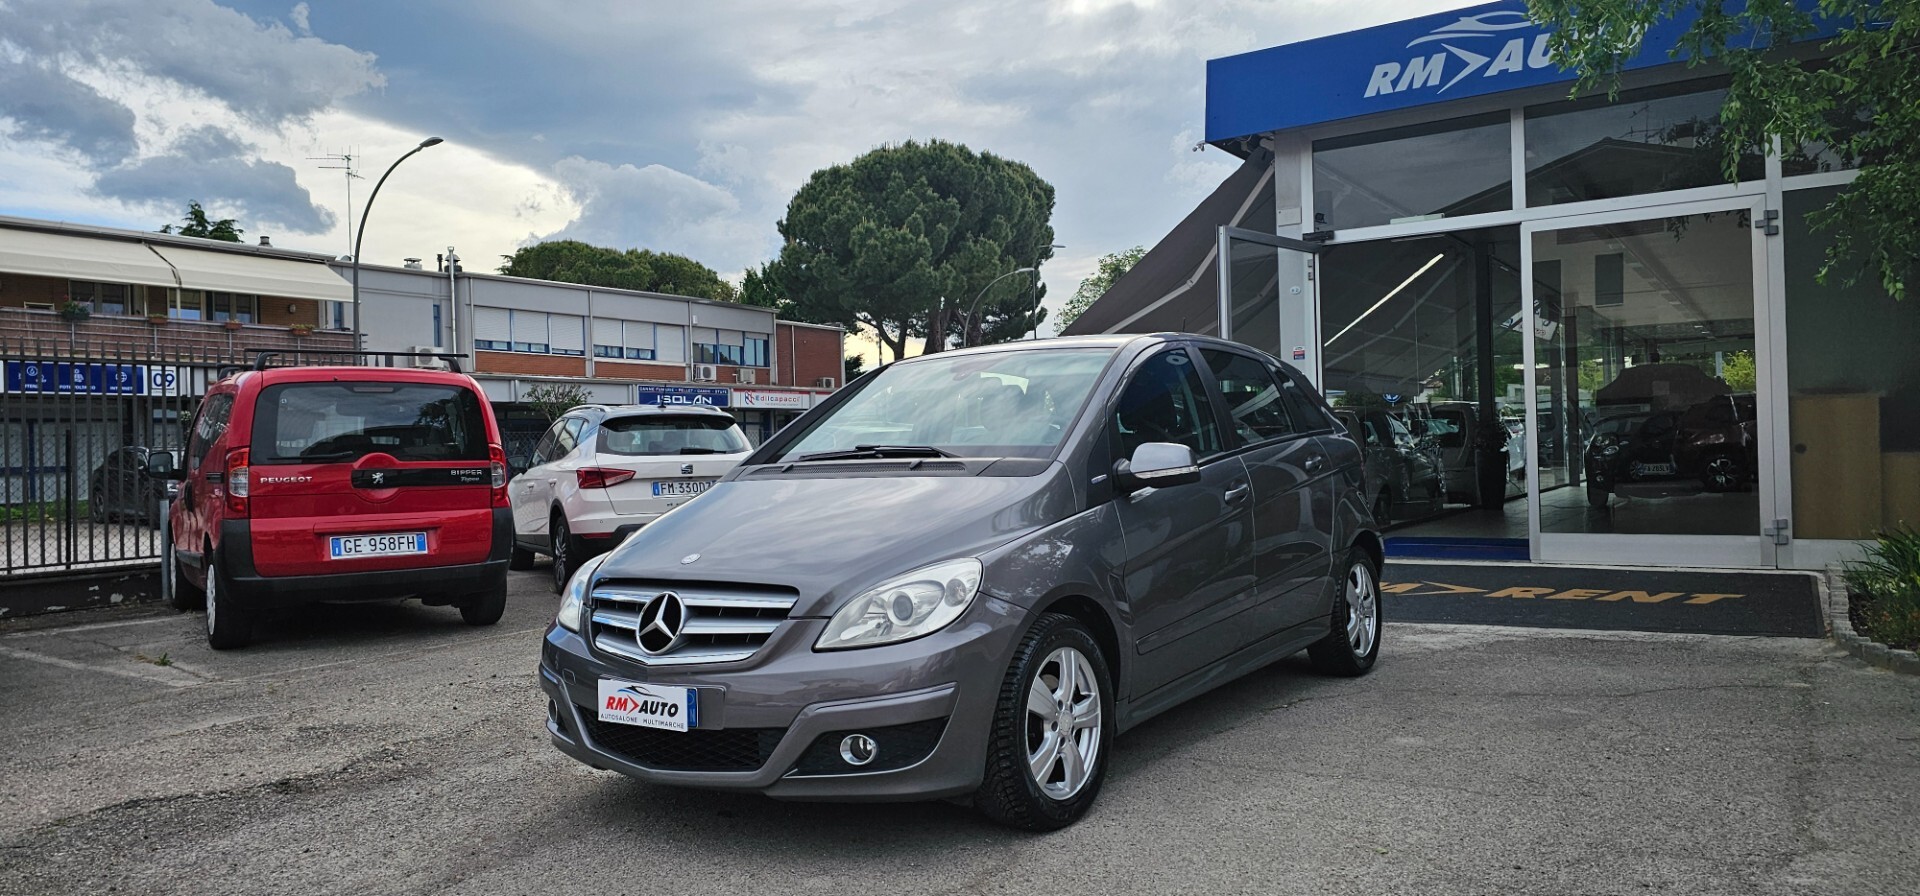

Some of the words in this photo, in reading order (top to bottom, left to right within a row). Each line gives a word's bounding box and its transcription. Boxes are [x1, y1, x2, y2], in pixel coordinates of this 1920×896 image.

[1363, 52, 1447, 98] RM
[1483, 22, 1648, 77] AU
[153, 372, 175, 388] 09
[660, 483, 675, 494] FM
[343, 538, 363, 553] GE
[369, 535, 416, 551] 958FH
[1484, 586, 1746, 604] RENT
[605, 695, 629, 711] RM
[638, 699, 679, 718] AUTO
[600, 713, 638, 724] AUTOSALONE
[643, 718, 684, 730] MULTIMARCHE
